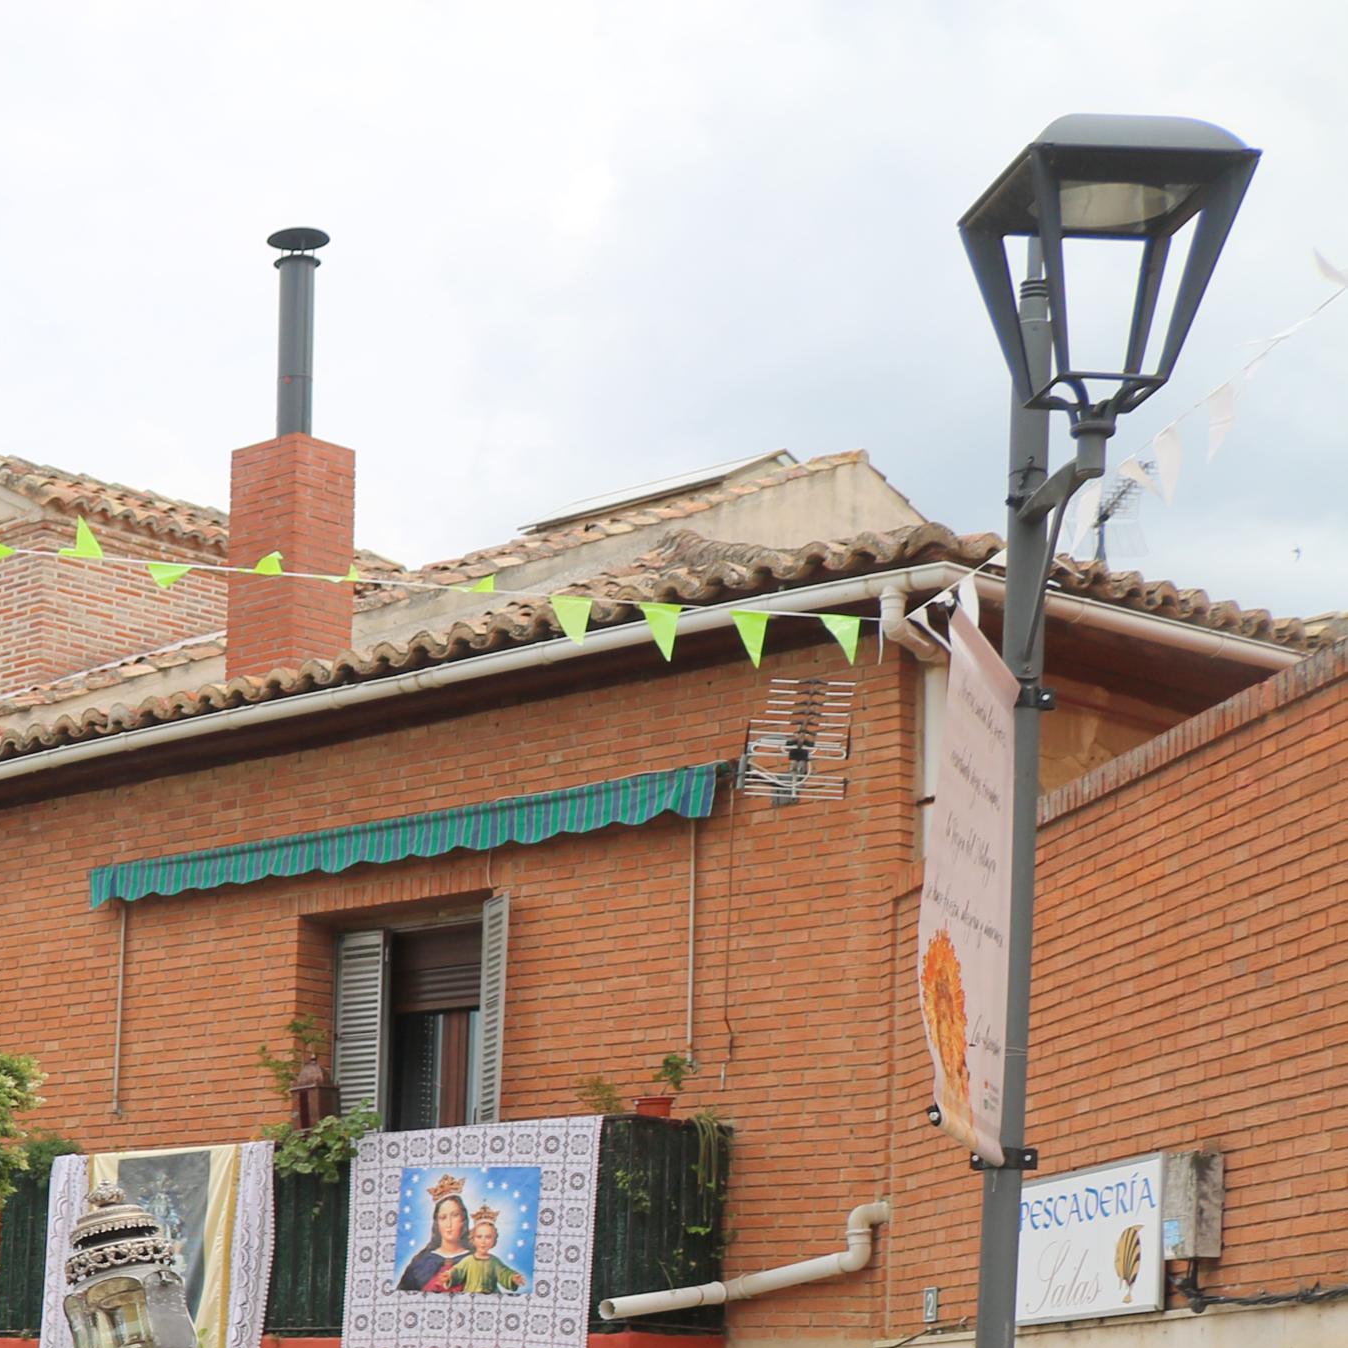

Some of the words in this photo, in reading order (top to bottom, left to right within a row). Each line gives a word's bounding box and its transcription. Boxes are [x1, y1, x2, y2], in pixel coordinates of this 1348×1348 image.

[1018, 1172, 1157, 1233] PESCADERÍA
[927, 1292, 935, 1317] 2
[1025, 1239, 1102, 1314] Salas
